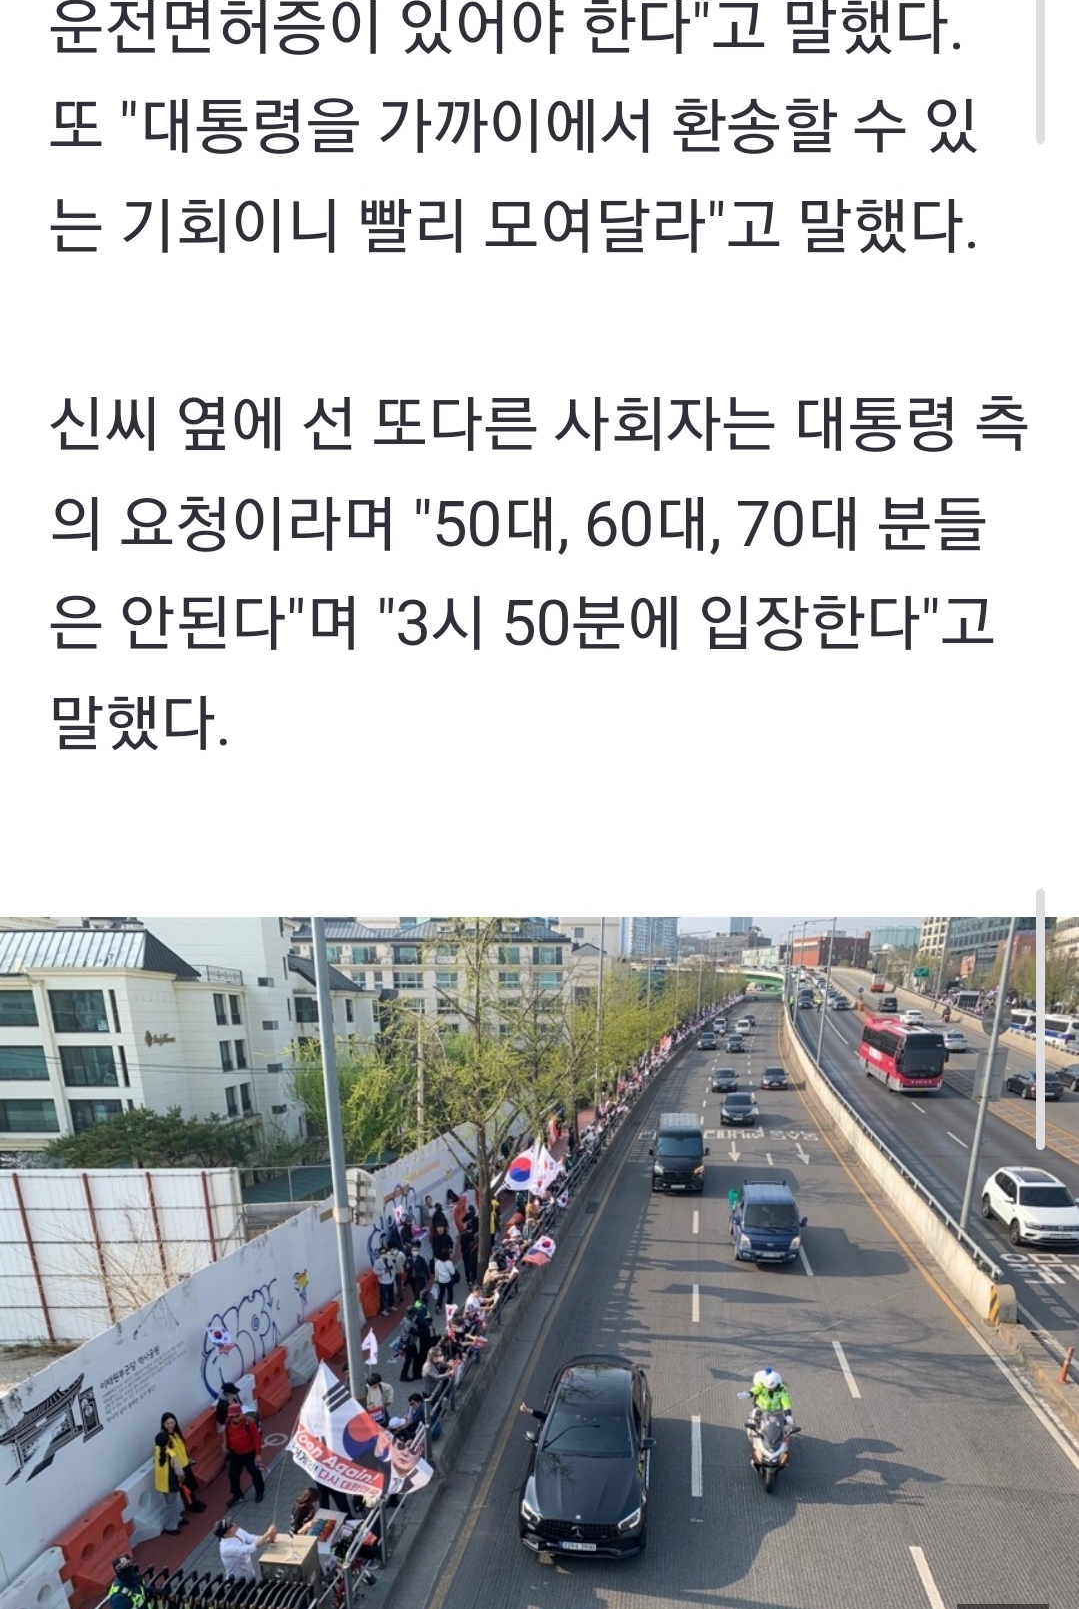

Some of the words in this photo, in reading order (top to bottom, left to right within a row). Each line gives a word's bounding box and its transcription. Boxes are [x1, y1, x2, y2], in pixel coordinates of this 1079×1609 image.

[49, 197, 103, 254] 는
[122, 197, 336, 255] 기회이니
[360, 197, 463, 255] 빨리
[484, 197, 781, 255] 모여달라"고
[800, 197, 977, 255] 말했다.
[49, 395, 156, 453] 신씨
[177, 395, 282, 453] 옆에
[302, 395, 353, 452] 선
[372, 395, 538, 453] 또다른
[553, 395, 776, 453] 사회자는
[797, 395, 954, 454] 대통령
[975, 394, 1029, 453] 측
[49, 594, 103, 651] 은
[121, 594, 356, 652] 안된다"며
[378, 594, 481, 652] "3시
[504, 594, 679, 652] 50분에
[700, 594, 995, 653] 입장한다"고
[52, 694, 229, 752] 말했다.
[322, 1455, 379, 1485] Again!
